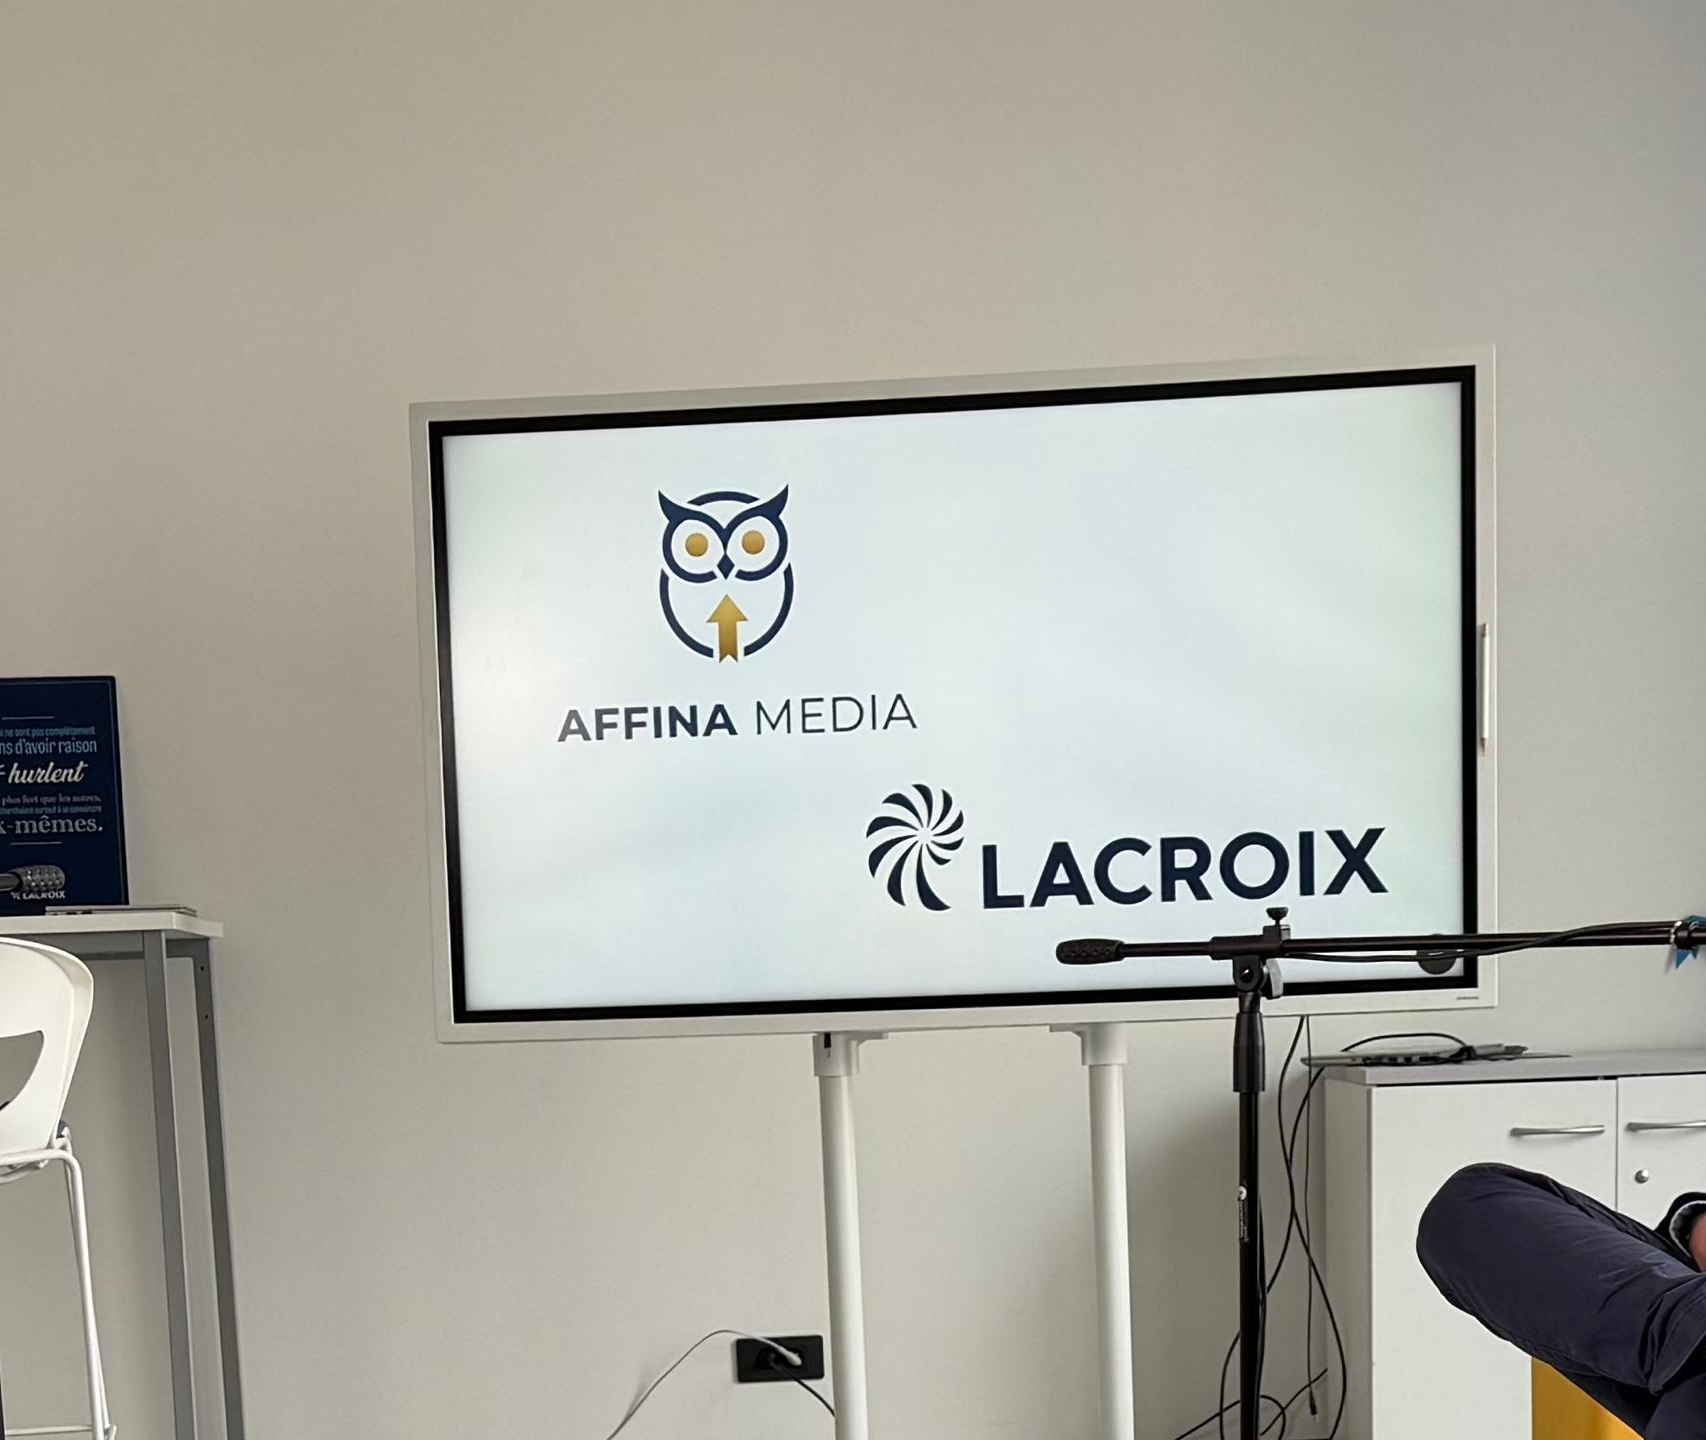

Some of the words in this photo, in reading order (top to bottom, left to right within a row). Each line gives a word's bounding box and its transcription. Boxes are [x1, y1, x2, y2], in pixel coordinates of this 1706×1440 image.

[557, 703, 739, 742] AFFINA
[756, 693, 918, 735] MEDIA
[15, 737, 56, 754] d'avoir
[58, 737, 98, 753] raison
[8, 761, 88, 783] hurlent
[982, 827, 1389, 909] LACROIX
